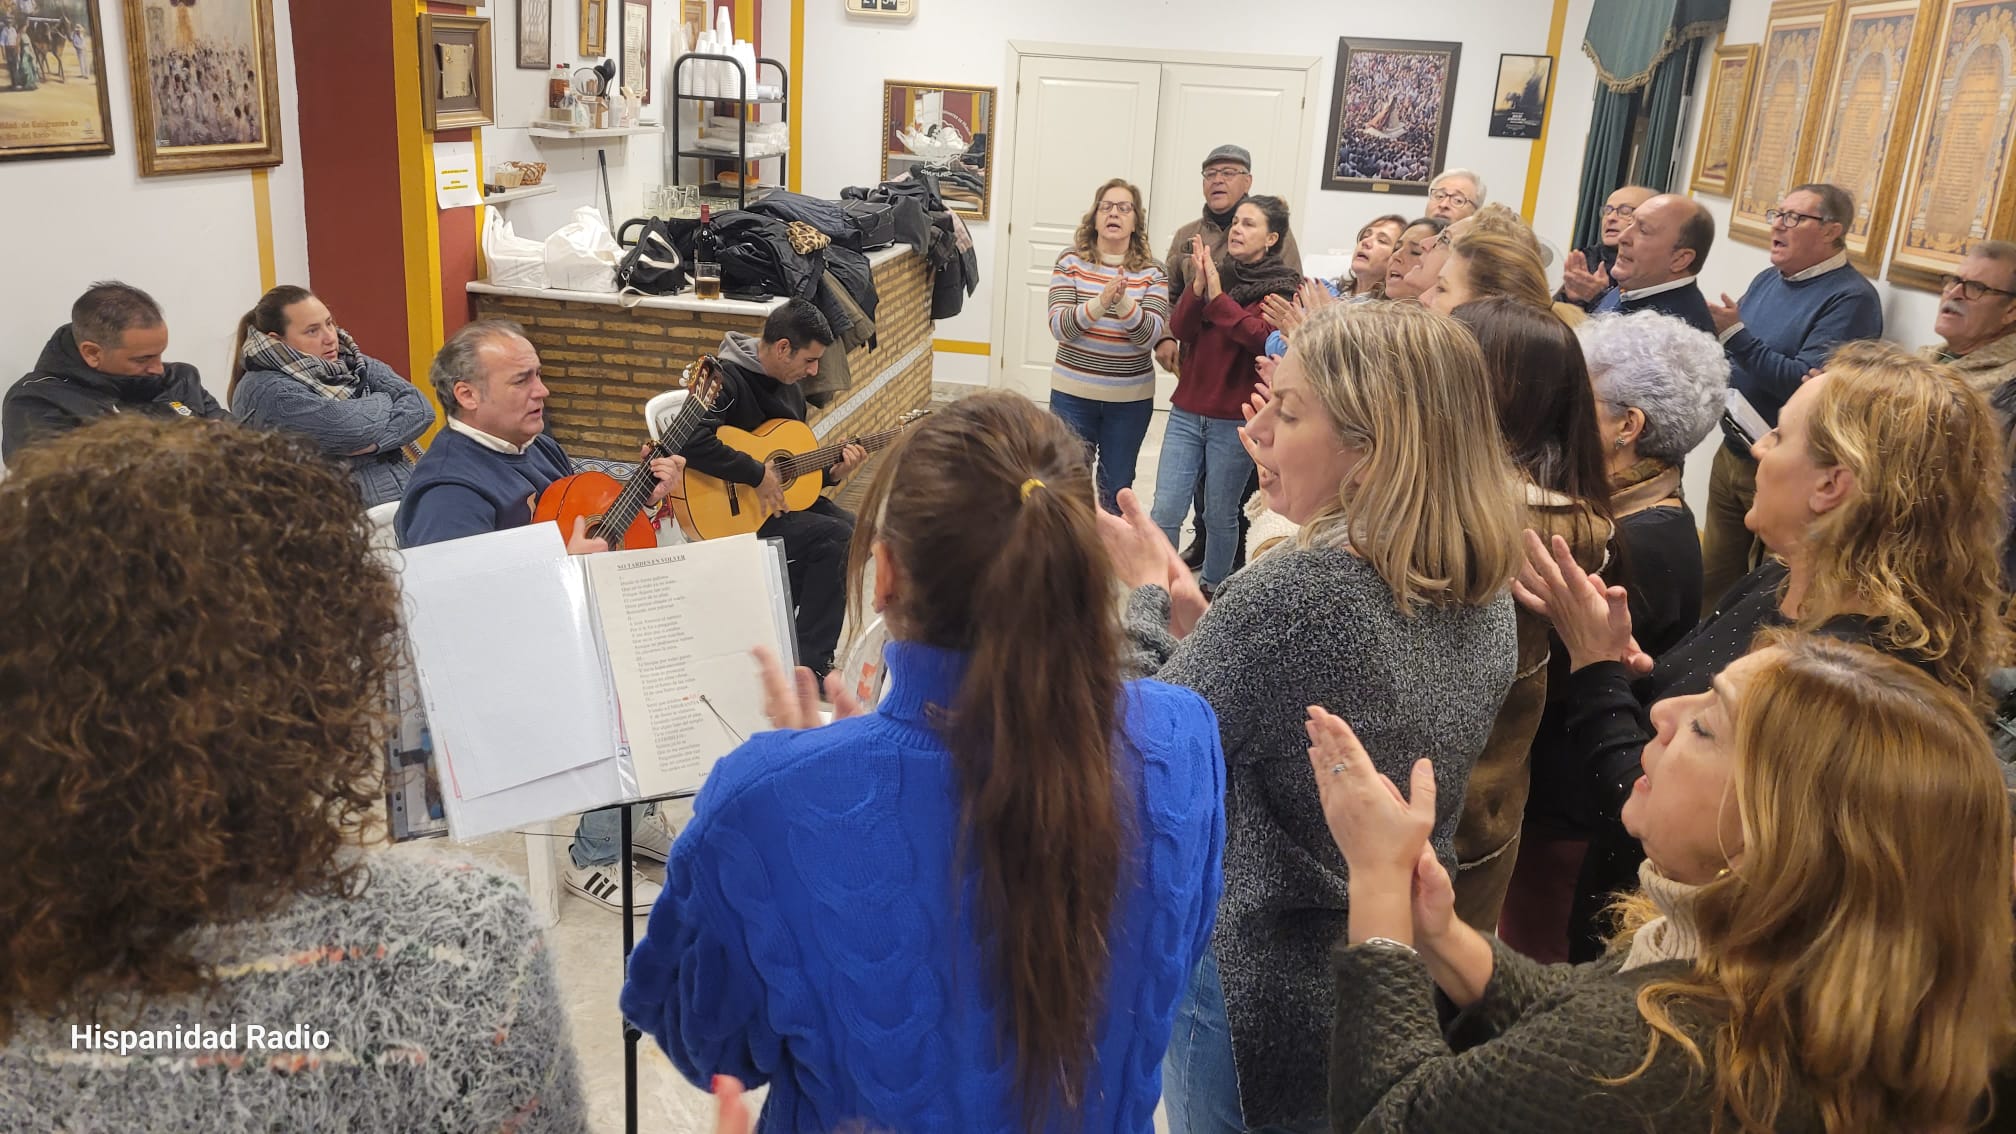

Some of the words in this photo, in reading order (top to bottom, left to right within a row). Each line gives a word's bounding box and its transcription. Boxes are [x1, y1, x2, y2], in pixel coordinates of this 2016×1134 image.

[627, 560, 651, 569] TARDES
[651, 558, 661, 566] EN
[660, 555, 686, 563] VOLVER
